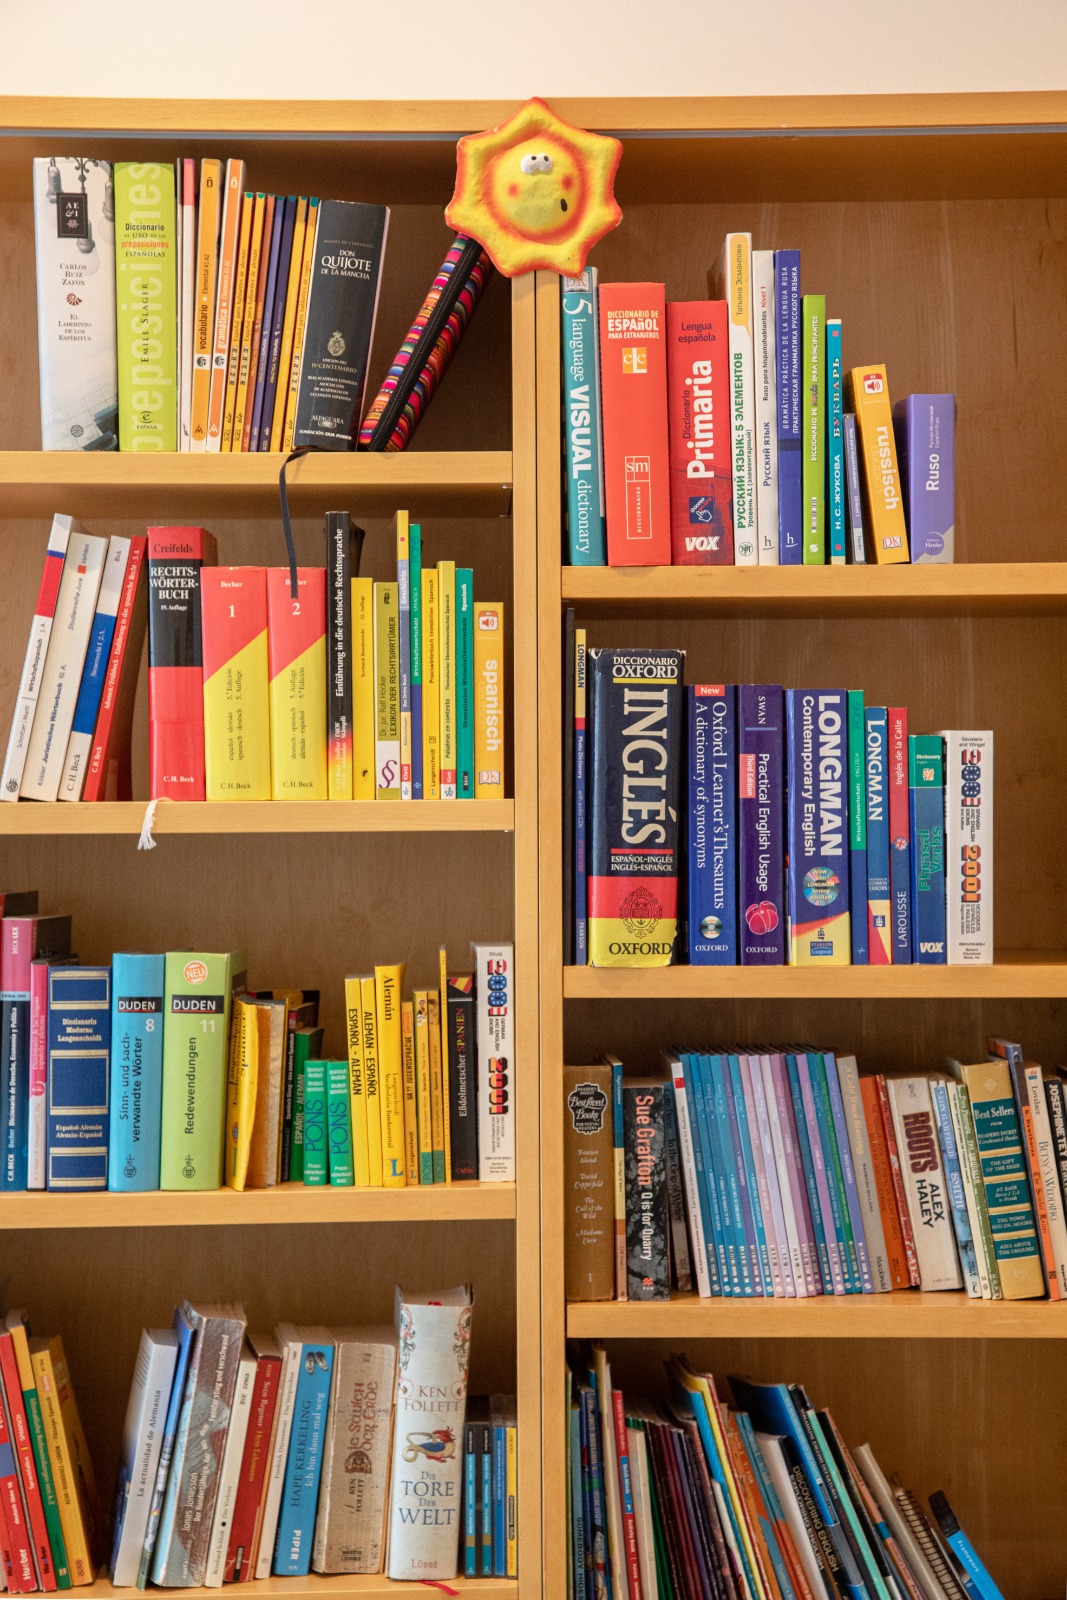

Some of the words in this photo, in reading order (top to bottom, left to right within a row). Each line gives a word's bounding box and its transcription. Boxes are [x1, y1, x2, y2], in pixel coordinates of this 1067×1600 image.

[126, 223, 165, 231] Diccionario
[121, 240, 169, 249] preposiciones
[339, 249, 355, 257] DON
[321, 255, 371, 272] QUIJOTE
[341, 270, 370, 279] MANCHA
[141, 283, 149, 323] SLAGER
[563, 298, 592, 315] 5
[607, 311, 648, 319] DICCIONARIO
[200, 305, 208, 349] vocabulario
[623, 331, 659, 339] EXTRANJEROS
[678, 334, 716, 343] española
[681, 322, 712, 333] Lengua
[141, 330, 149, 362] EMILE
[570, 318, 585, 382] language
[570, 384, 591, 479] VISUAL
[687, 360, 714, 479] Primaria
[763, 448, 772, 487] Русский
[876, 425, 901, 511] russisch
[926, 453, 940, 491] Ruso
[576, 480, 592, 554] dictionary
[153, 544, 193, 554] Creifelds
[150, 575, 199, 589] WÖRTER-
[151, 567, 197, 577] RECHTS-
[158, 589, 189, 600] BUCH
[292, 603, 301, 615] 2
[229, 605, 235, 617] 1
[387, 616, 396, 684] RECHTSIRRTÜMER
[613, 656, 678, 666] DICCIONARIO
[612, 665, 679, 678] OXFORD
[485, 659, 502, 751] spanisch
[696, 702, 708, 713] A
[712, 701, 728, 756] Oxford
[693, 718, 708, 784] dictionary
[800, 696, 815, 799] Contemporary
[621, 688, 678, 844] INGLÉS
[757, 753, 770, 805] Practical
[818, 695, 843, 856] LONGMAN
[867, 719, 885, 821] LONGMAN
[961, 749, 981, 807] 2001
[695, 787, 709, 803] of
[693, 803, 707, 868] synonyms
[757, 807, 770, 850] English
[802, 803, 816, 856] English
[611, 853, 674, 863] ESPAÑOL-INGLÉS
[918, 829, 930, 891] Phrasal
[930, 826, 942, 874] Verbs
[611, 862, 674, 872] INGLÉS-ESPAÑOL
[713, 833, 729, 912] Thesaurus
[757, 853, 770, 892] Usage
[961, 845, 981, 903] 2001
[898, 891, 907, 947] LAROUSSE
[609, 941, 672, 955] OXFORD
[695, 944, 728, 952] OXFORD
[746, 946, 777, 954] OXFORD
[186, 967, 203, 978] NEU
[488, 959, 508, 1017] 2001
[118, 1000, 155, 1010] DUDEN
[173, 1000, 216, 1011] DUDEN
[383, 975, 394, 1021] Alemán
[57, 1034, 102, 1042] Langenscheidt
[62, 1018, 97, 1026] Diccionario
[145, 1019, 155, 1032] 8
[200, 1019, 215, 1032] 11
[348, 1008, 359, 1049] ESPAÑOL
[364, 1012, 374, 1049] ALEMAN
[121, 1032, 129, 1062] sach-
[132, 1037, 142, 1073] Wörter
[121, 1066, 129, 1087] und
[185, 1037, 199, 1134] Redewendungen
[351, 1057, 362, 1095] ALEMAN
[366, 1057, 377, 1099] ESPAÑOL
[459, 1054, 467, 1118] Eßdolmetscher
[488, 1057, 509, 1115] 2001
[120, 1092, 129, 1120] Sinn-
[133, 1078, 141, 1142] verwandte
[575, 1109, 600, 1121] Books
[636, 1095, 654, 1124] Sue
[974, 1109, 990, 1119] Best
[990, 1105, 1015, 1117] Sellers
[1032, 1085, 1040, 1115] Lovelace
[305, 1100, 323, 1152] PONS
[329, 1102, 348, 1154] PONS
[637, 1130, 655, 1186] Grafton
[902, 1111, 939, 1174] ROOTS
[642, 1203, 650, 1211] is
[916, 1179, 934, 1228] HALEY
[929, 1183, 945, 1221] ALEX
[641, 1212, 654, 1227] for
[640, 1228, 654, 1261] Quarry
[403, 1398, 460, 1412] FOLLETT
[419, 1385, 447, 1398] KEN
[151, 1390, 162, 1427] Alemania
[149, 1430, 154, 1441] de
[295, 1399, 311, 1478] KERKELING
[140, 1442, 154, 1485] actualidad
[421, 1471, 436, 1480] DIE
[812, 1440, 824, 1465] ENGLISH
[821, 1464, 838, 1500] DEPARTURES
[137, 1487, 144, 1496] La
[186, 1472, 198, 1503] Jonasson
[291, 1479, 300, 1507] HAPE
[401, 1480, 454, 1497] TORE
[419, 1498, 436, 1507] DER
[182, 1503, 195, 1533] Jonas
[398, 1508, 455, 1525] WELT
[790, 1474, 811, 1531] EXPLORING
[807, 1531, 825, 1570] ENGLISH
[792, 1465, 823, 1531] DISCOVERING
[817, 1524, 839, 1572] ENGLISH
[290, 1529, 301, 1561] PIPER
[957, 1540, 979, 1573] Framework
[411, 1560, 438, 1569] LÜBBE
